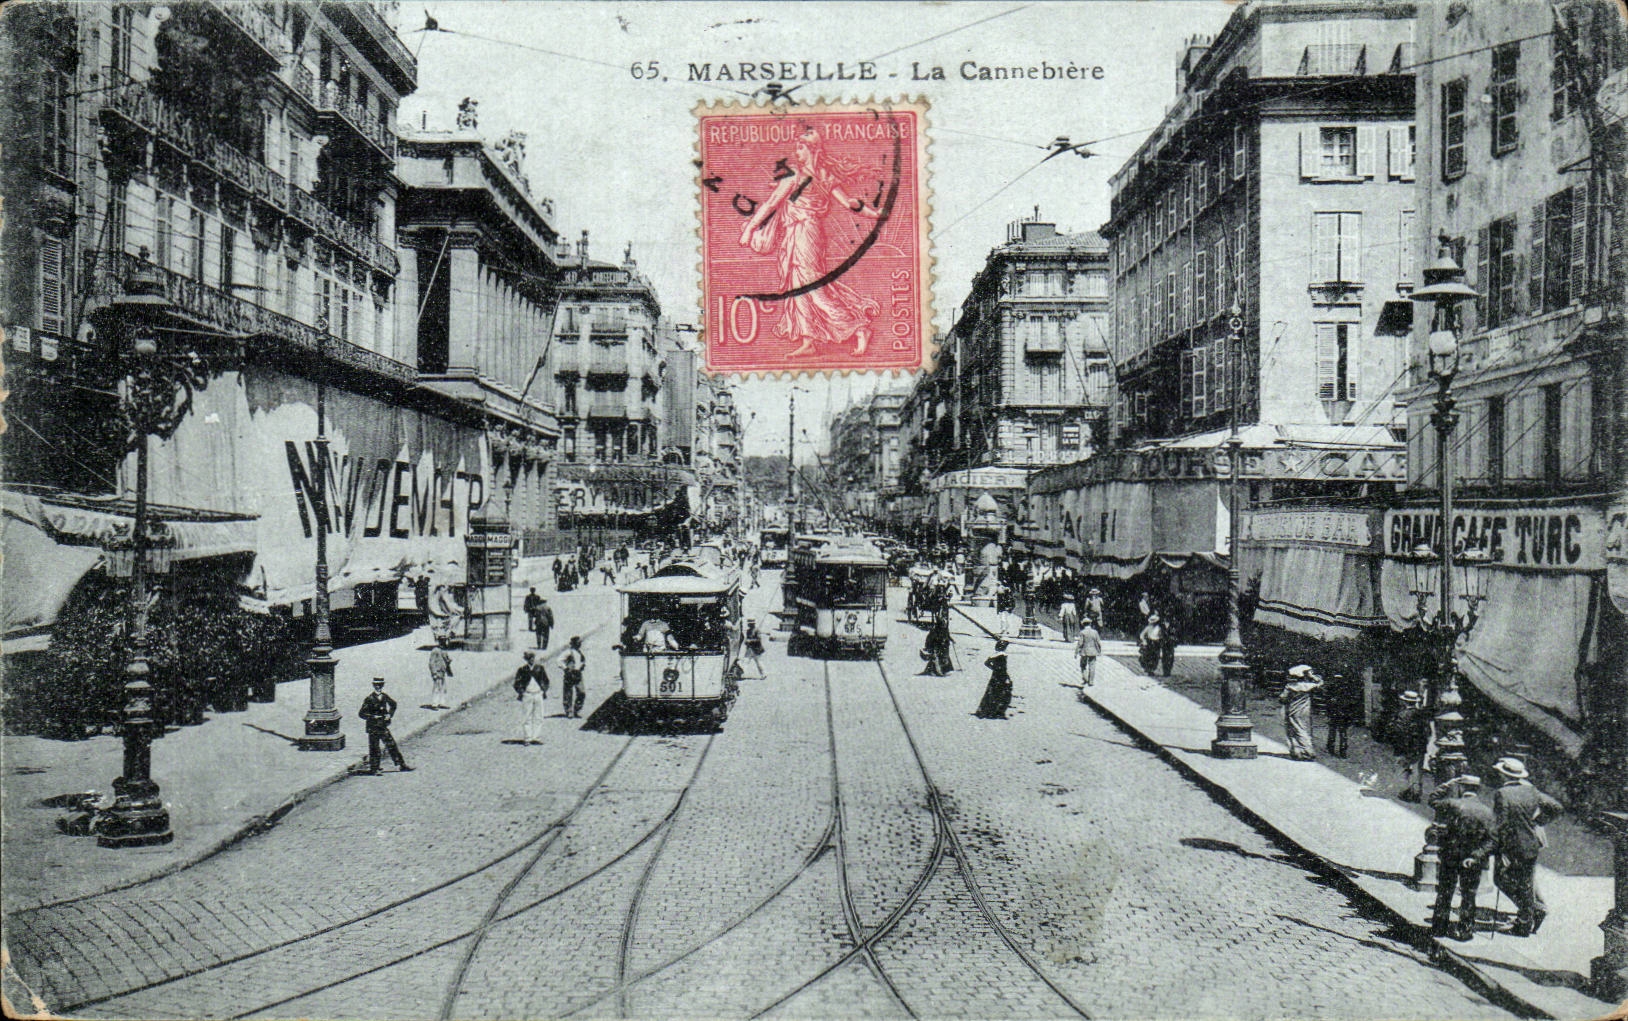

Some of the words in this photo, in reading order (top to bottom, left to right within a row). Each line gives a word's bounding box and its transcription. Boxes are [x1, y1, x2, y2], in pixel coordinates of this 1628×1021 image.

[823, 120, 909, 141] FRANÇAISE
[891, 268, 911, 352] POSTES
[1515, 513, 1582, 565] TURC
[659, 681, 684, 694] 501
